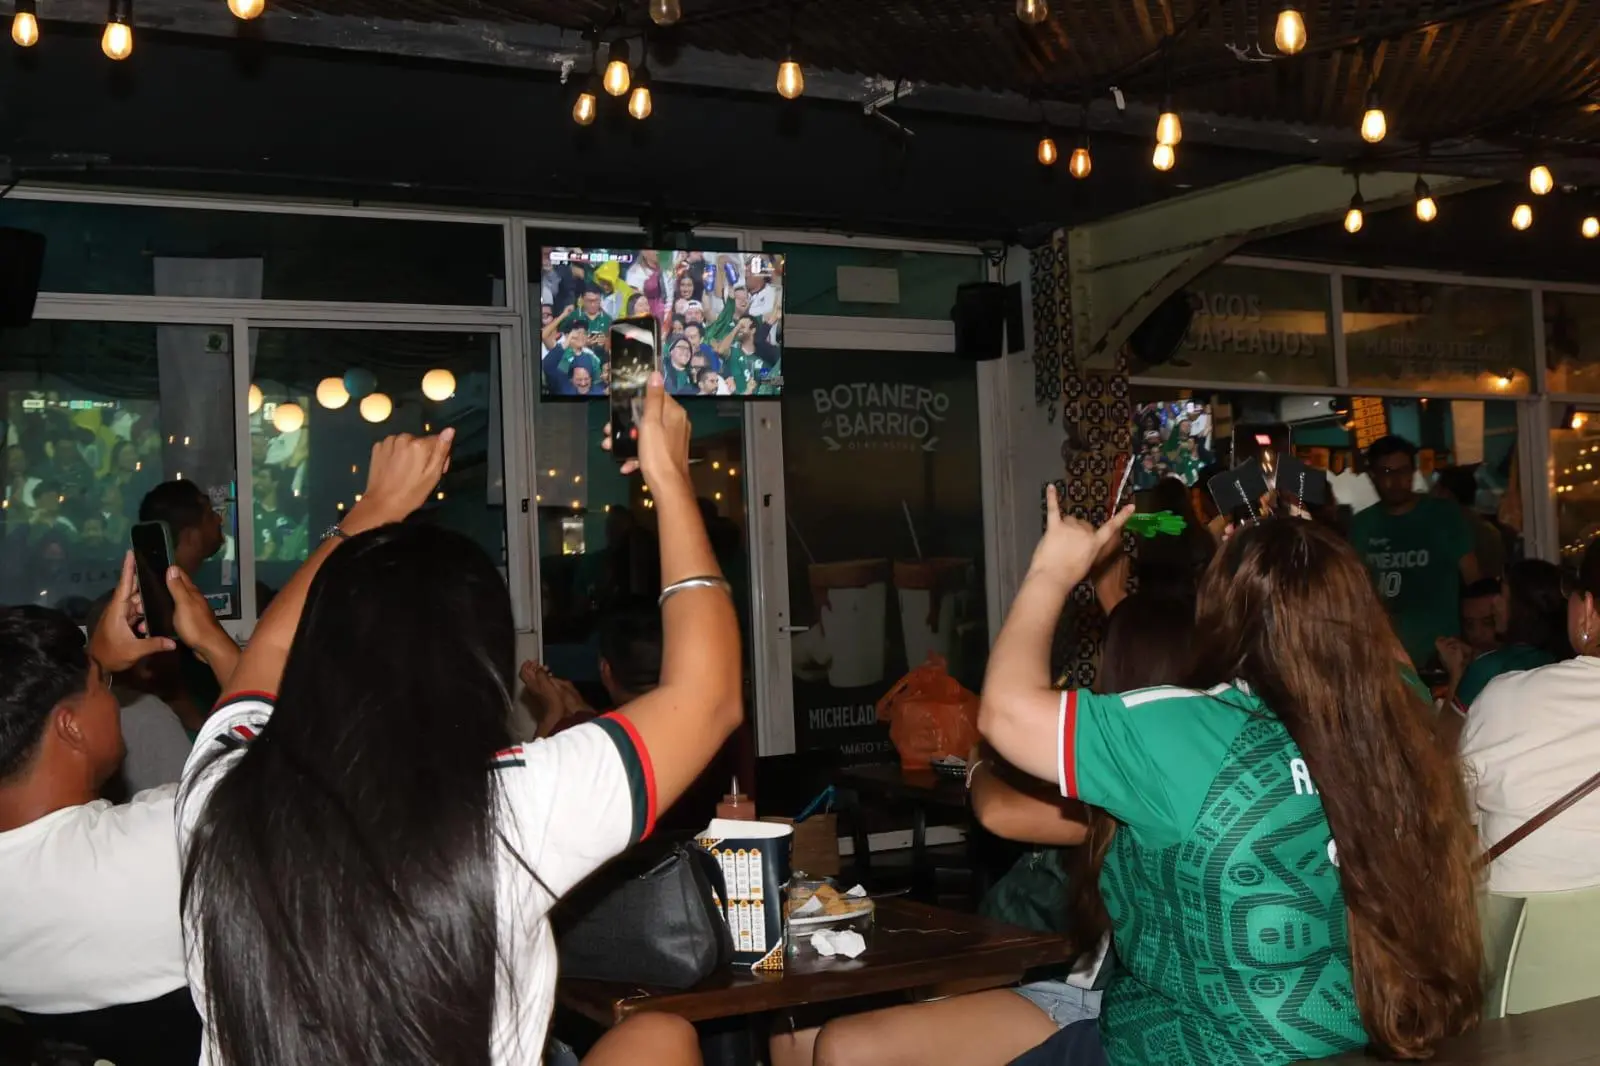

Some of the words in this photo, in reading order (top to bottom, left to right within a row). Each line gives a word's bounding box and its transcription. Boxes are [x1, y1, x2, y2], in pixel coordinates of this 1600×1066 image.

[812, 382, 950, 421] BOTANERO
[836, 411, 929, 438] BARRIO
[809, 704, 877, 730] MICHELAD
